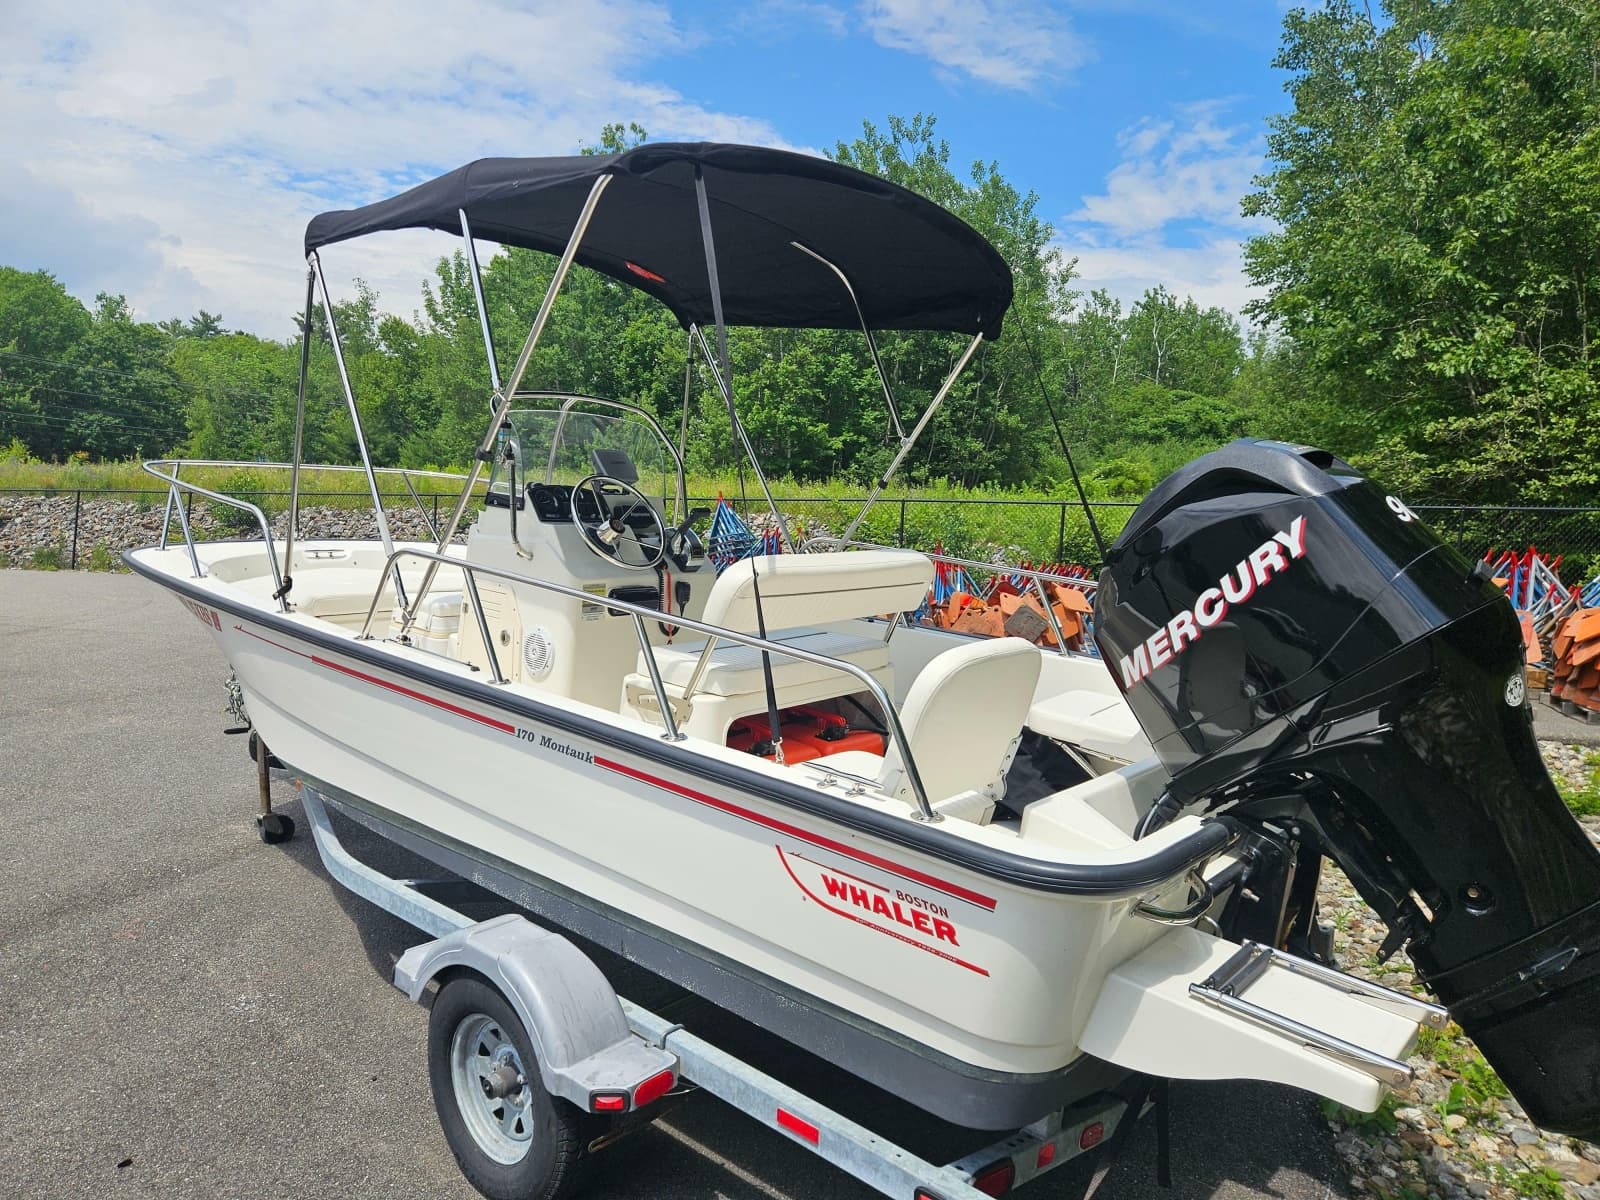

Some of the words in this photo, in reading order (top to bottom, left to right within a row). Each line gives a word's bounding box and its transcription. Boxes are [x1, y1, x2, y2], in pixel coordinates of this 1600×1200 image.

[1119, 515, 1307, 689] MERCURY
[516, 728, 535, 743] 170
[539, 735, 593, 764] Montauk
[820, 873, 961, 947] WHALER
[895, 889, 949, 919] BOSTON
